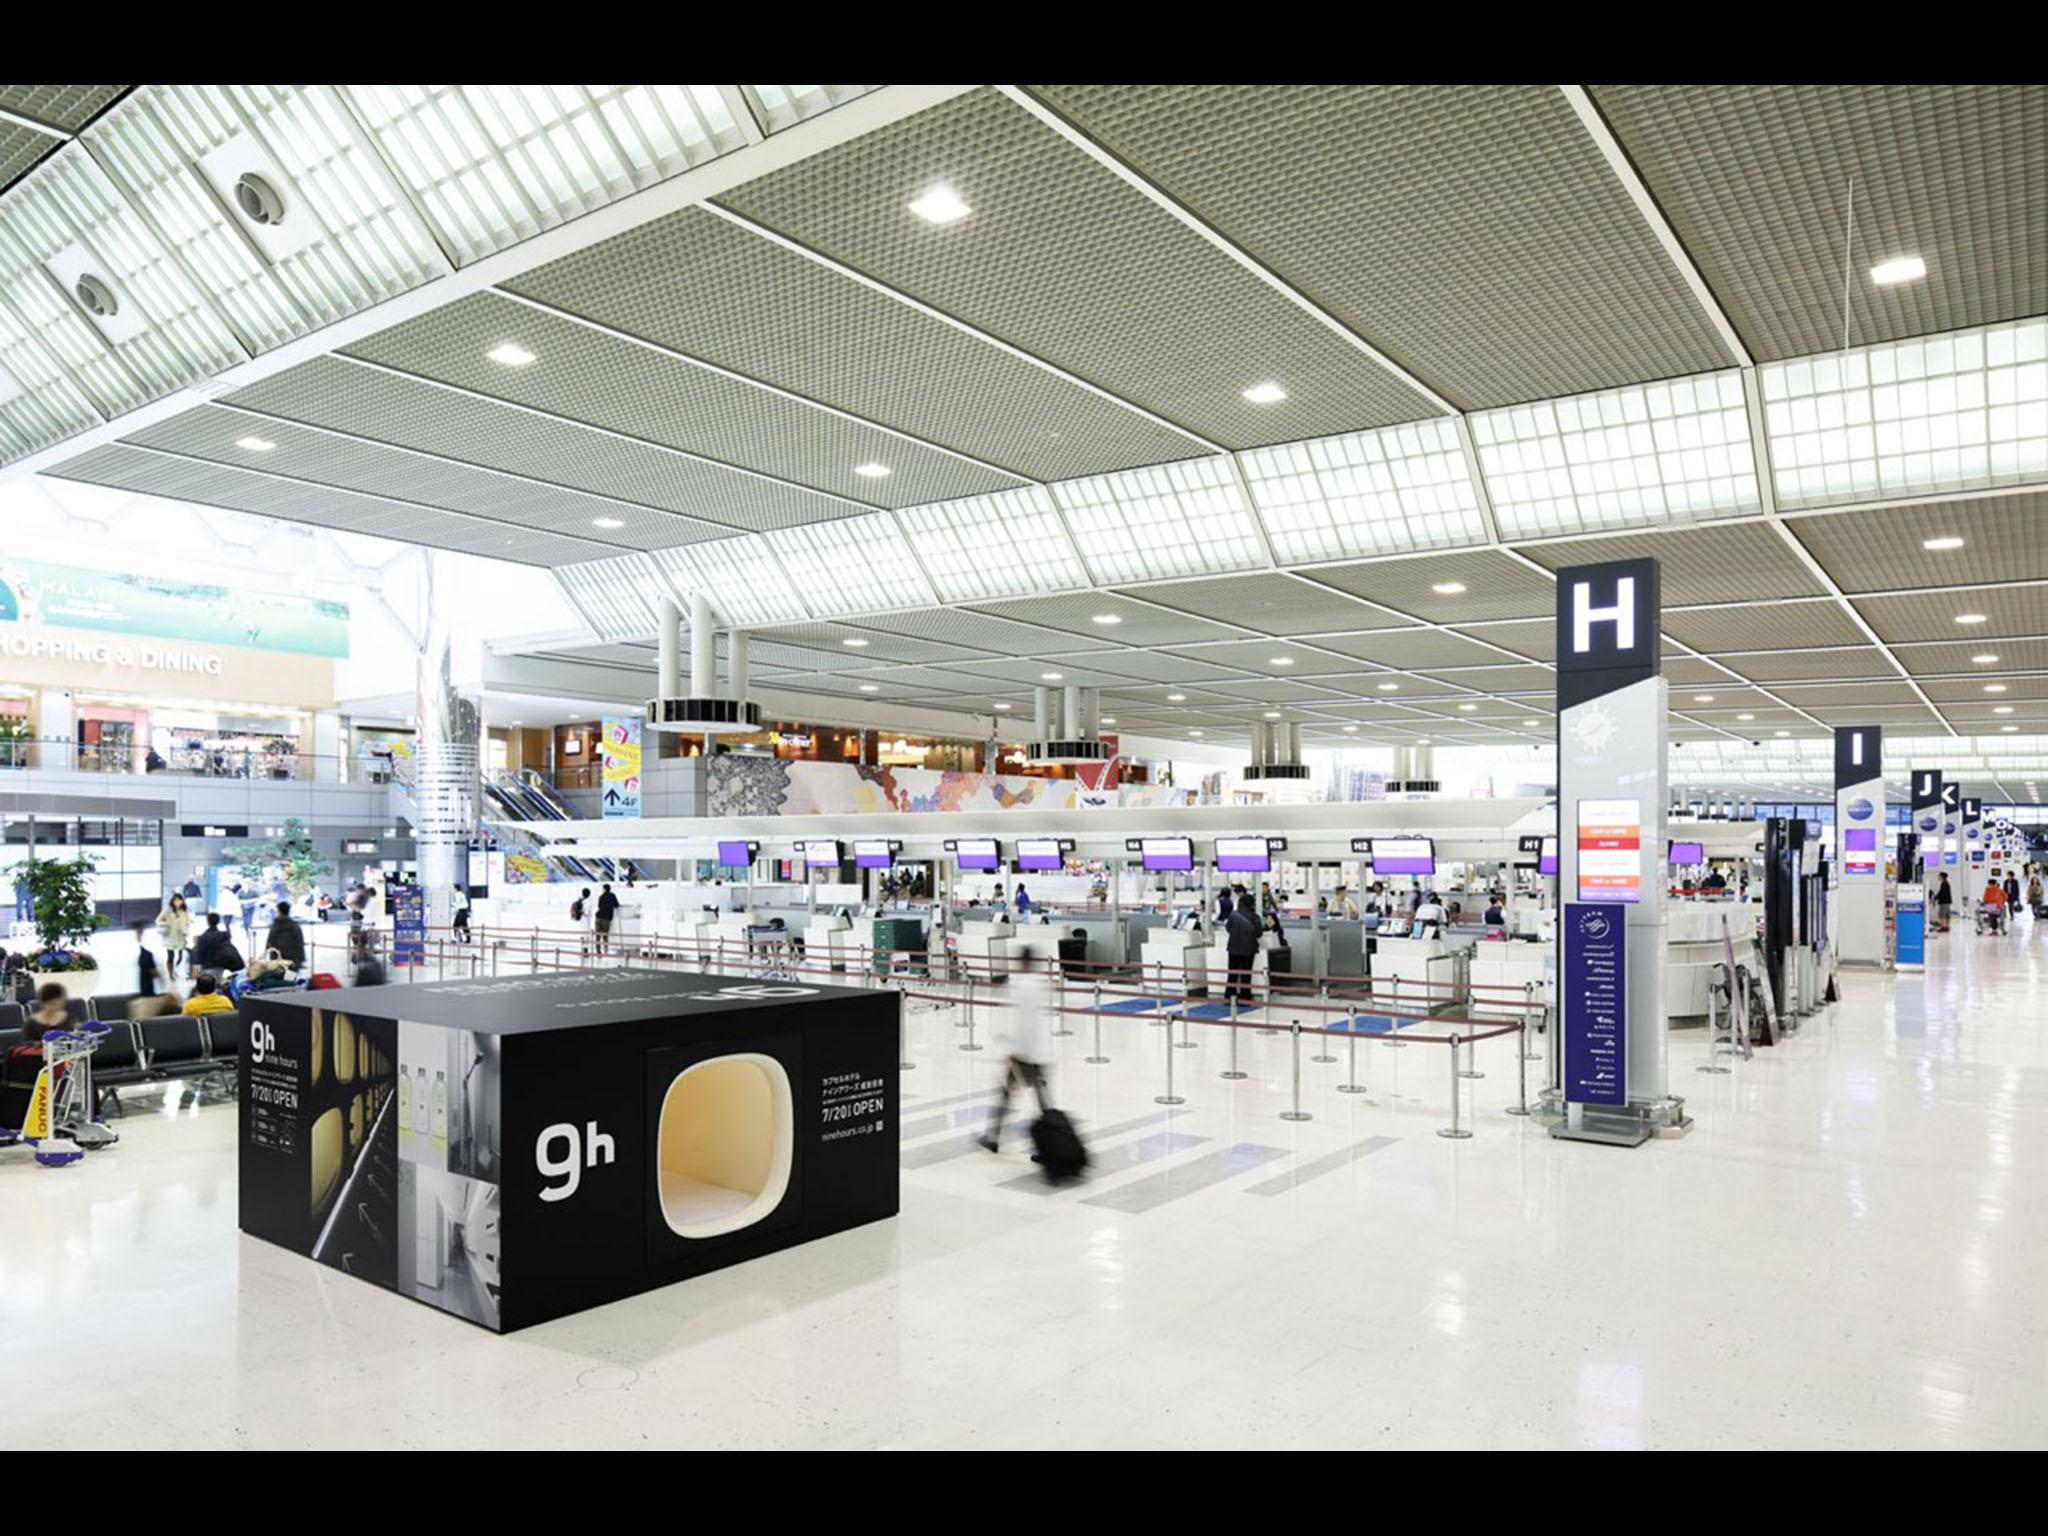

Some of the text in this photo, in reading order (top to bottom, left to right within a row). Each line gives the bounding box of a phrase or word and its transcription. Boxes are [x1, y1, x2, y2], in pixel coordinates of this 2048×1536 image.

[1573, 576, 1635, 653] H
[118, 645, 133, 667] &
[141, 649, 222, 675] DINING
[1852, 733, 1863, 766] I
[1919, 773, 1933, 797] J
[621, 796, 638, 807] 4F
[1965, 800, 1979, 816] L
[1353, 840, 1369, 851] H2
[1524, 838, 1539, 850] H1
[273, 1088, 298, 1109] OPEN
[822, 1104, 848, 1123] 7/20
[853, 1098, 883, 1116] OPEN
